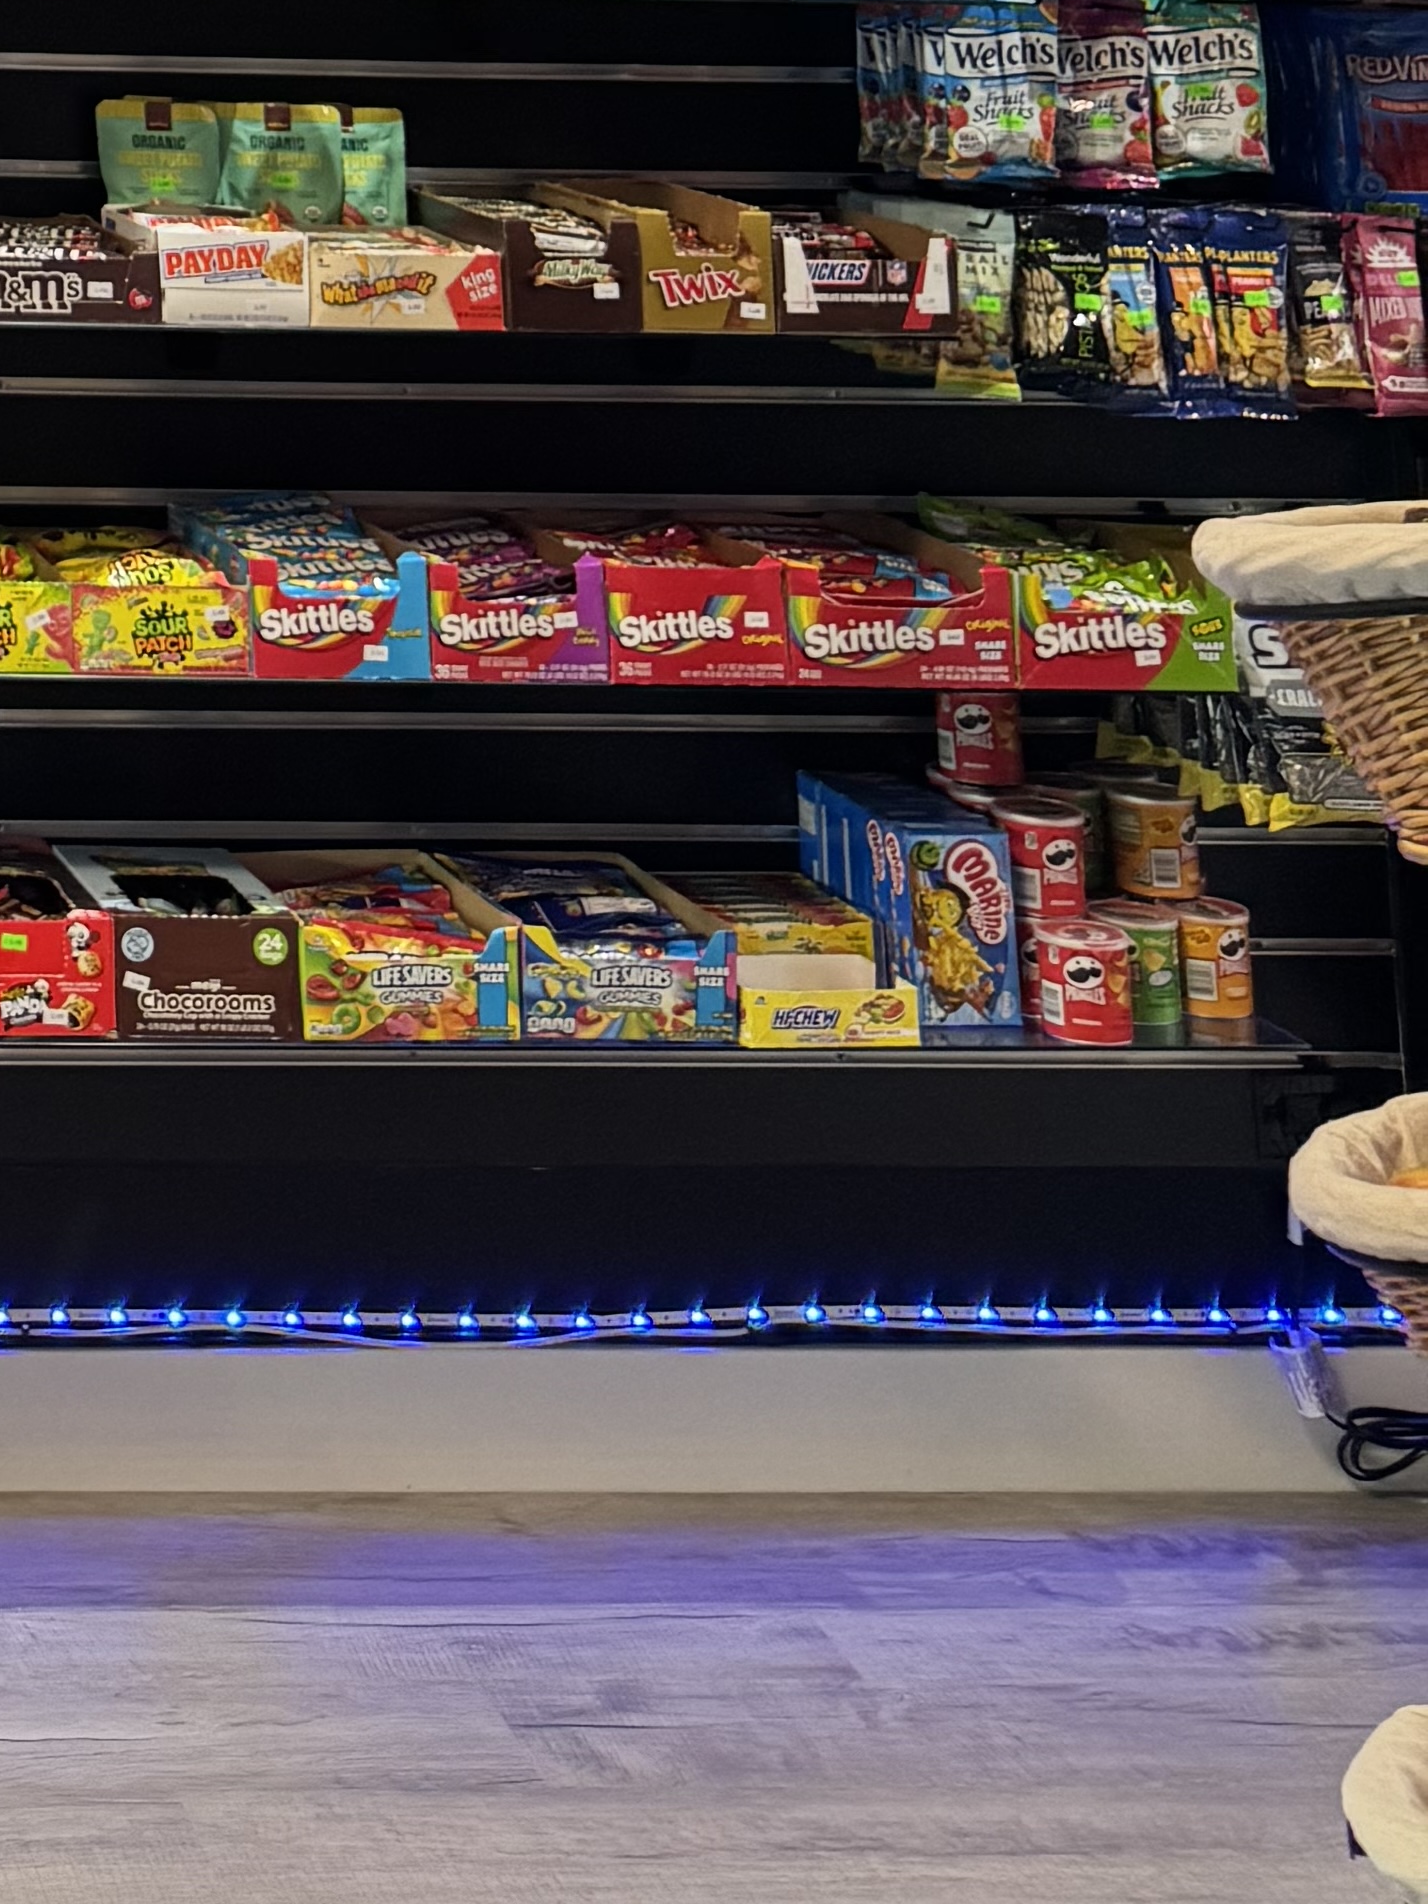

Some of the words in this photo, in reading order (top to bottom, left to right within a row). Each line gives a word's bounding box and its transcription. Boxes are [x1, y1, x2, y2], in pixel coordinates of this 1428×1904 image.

[951, 35, 1054, 72] Welch's
[1148, 36, 1253, 67] Welch's
[984, 90, 1026, 109] Fruit
[1170, 99, 1235, 117] Snacks
[972, 102, 1034, 125] Snacks
[132, 134, 185, 149] ORGANIC
[250, 136, 305, 150] ORGANIC
[164, 244, 269, 277] PAYDAY
[1219, 249, 1279, 266] PLANTERS
[462, 269, 496, 289] king
[651, 263, 744, 307] Twix
[469, 284, 497, 302] size
[131, 616, 188, 636] SOUR
[260, 607, 374, 640] Skittles
[441, 610, 555, 645] Skittles
[619, 612, 734, 647] Skittles
[132, 633, 192, 654] PATCH
[804, 621, 935, 658] Skittles
[1035, 616, 1166, 659] Skittles
[257, 934, 283, 950] 24
[474, 962, 510, 973] SHARE
[480, 972, 504, 983] SIZE
[137, 991, 275, 1013] Chocorooms
[379, 990, 442, 1004] GUMMIES
[773, 1008, 837, 1030] HI-CHEW
